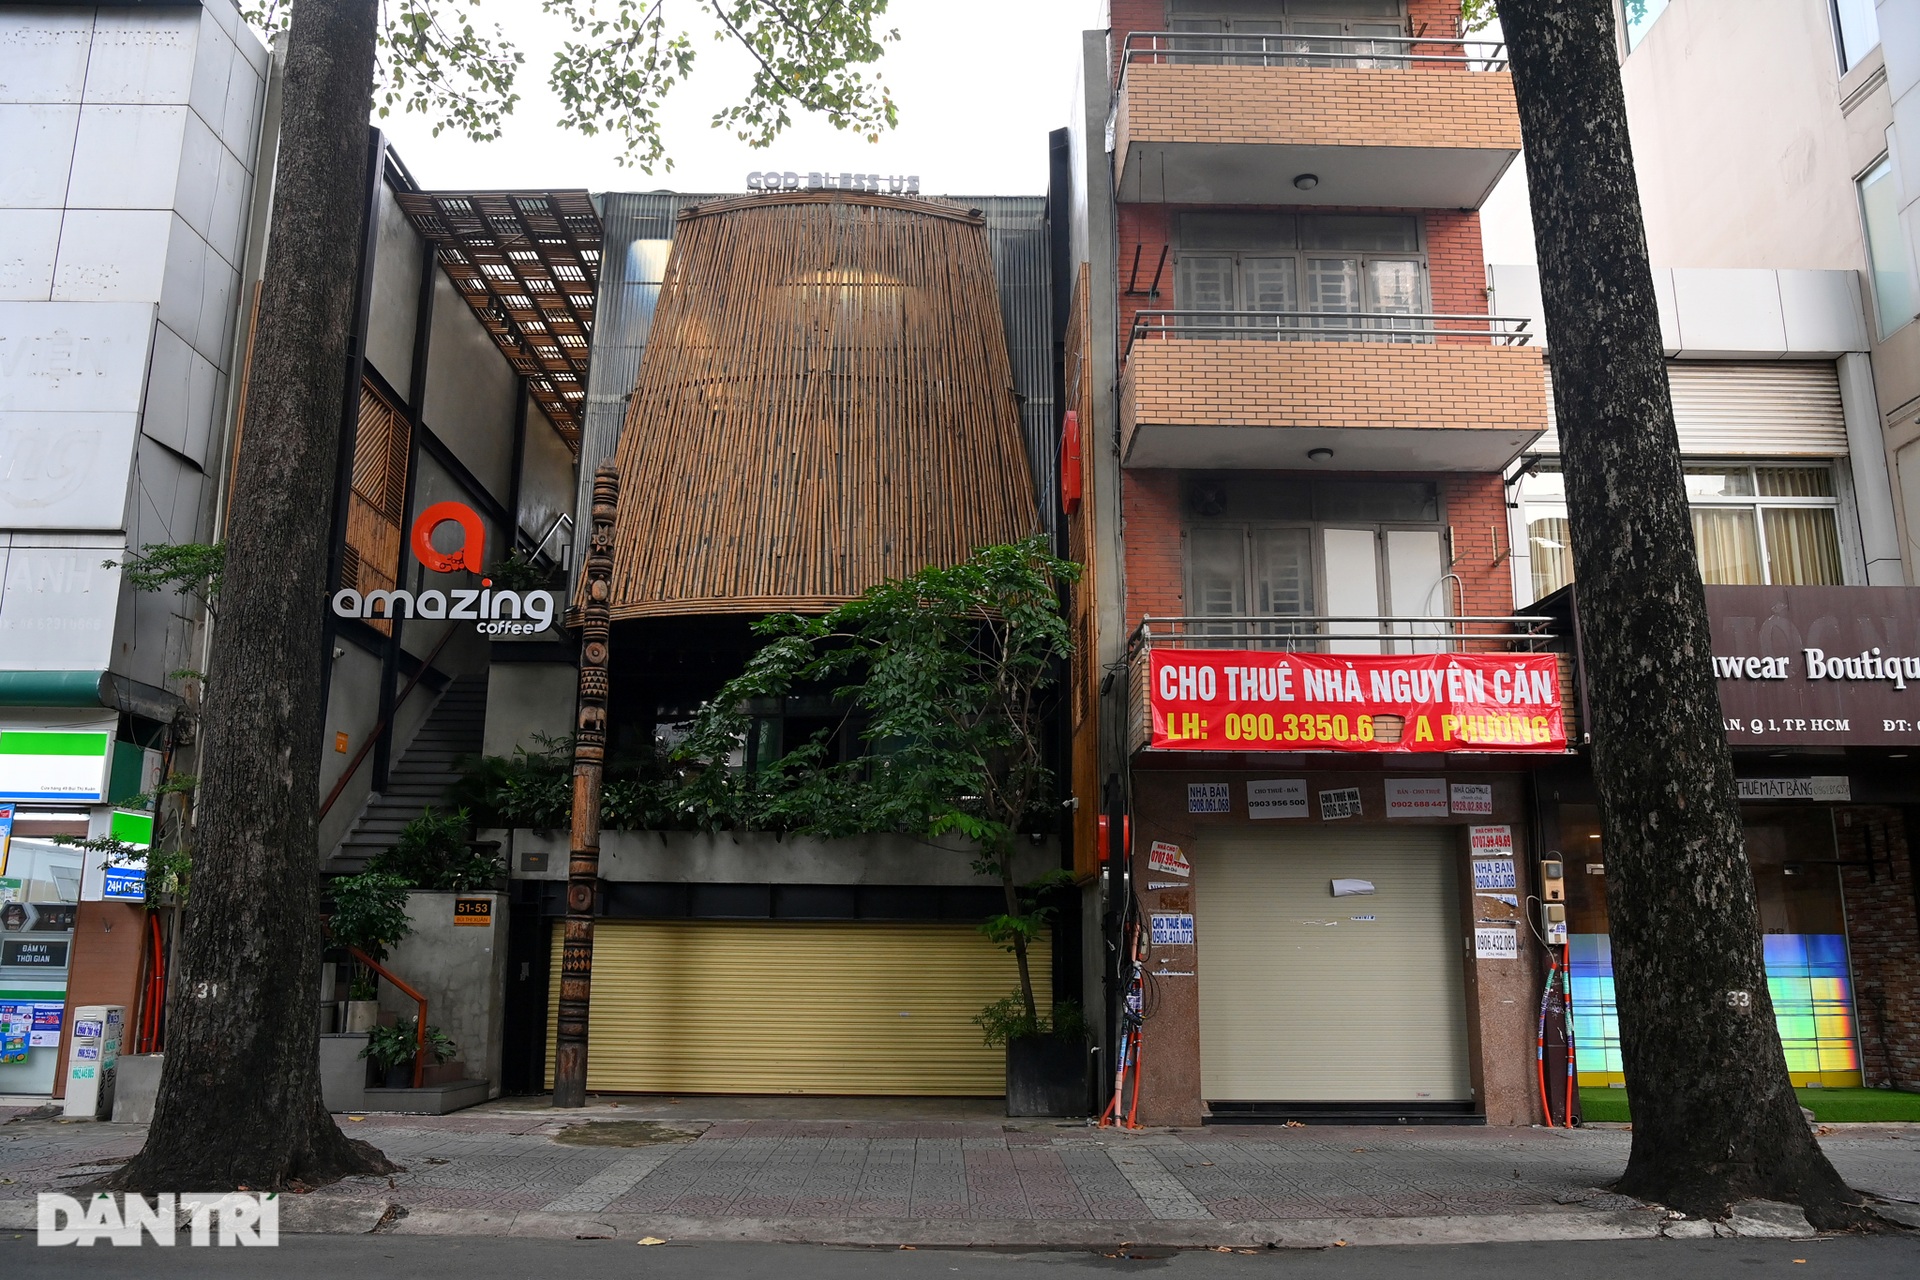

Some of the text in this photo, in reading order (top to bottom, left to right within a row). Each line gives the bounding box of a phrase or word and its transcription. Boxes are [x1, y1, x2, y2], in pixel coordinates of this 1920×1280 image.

[746, 172, 920, 194] GOD BLESS US
[332, 578, 554, 632] amazing
[476, 620, 534, 634] coffee
[1159, 661, 1553, 704] CHO THUÊ NHÀ NGUYÊN CĂN
[1167, 712, 1551, 743] LH: 090.3350.6 A PHƯƠNG
[1783, 719, 1807, 732] TP.
[1811, 718, 1850, 731] HCM
[1884, 720, 1912, 732] ĐT:
[1190, 784, 1227, 798] NHÀ BÁN
[1760, 780, 1786, 797] MẶT
[1475, 860, 1492, 874] NHÀ
[107, 880, 122, 892] 24H
[1476, 874, 1515, 888] 0908.061.068
[458, 903, 488, 913] 51-53
[1152, 918, 1164, 929] CHO
[1165, 915, 1180, 929] THUÊ
[1152, 931, 1193, 944] 0903.410.073
[22, 944, 47, 954] ĐẬM VỊ
[17, 954, 50, 963] THỜI GIAN
[198, 982, 218, 999] 31
[1727, 991, 1750, 1007] 33
